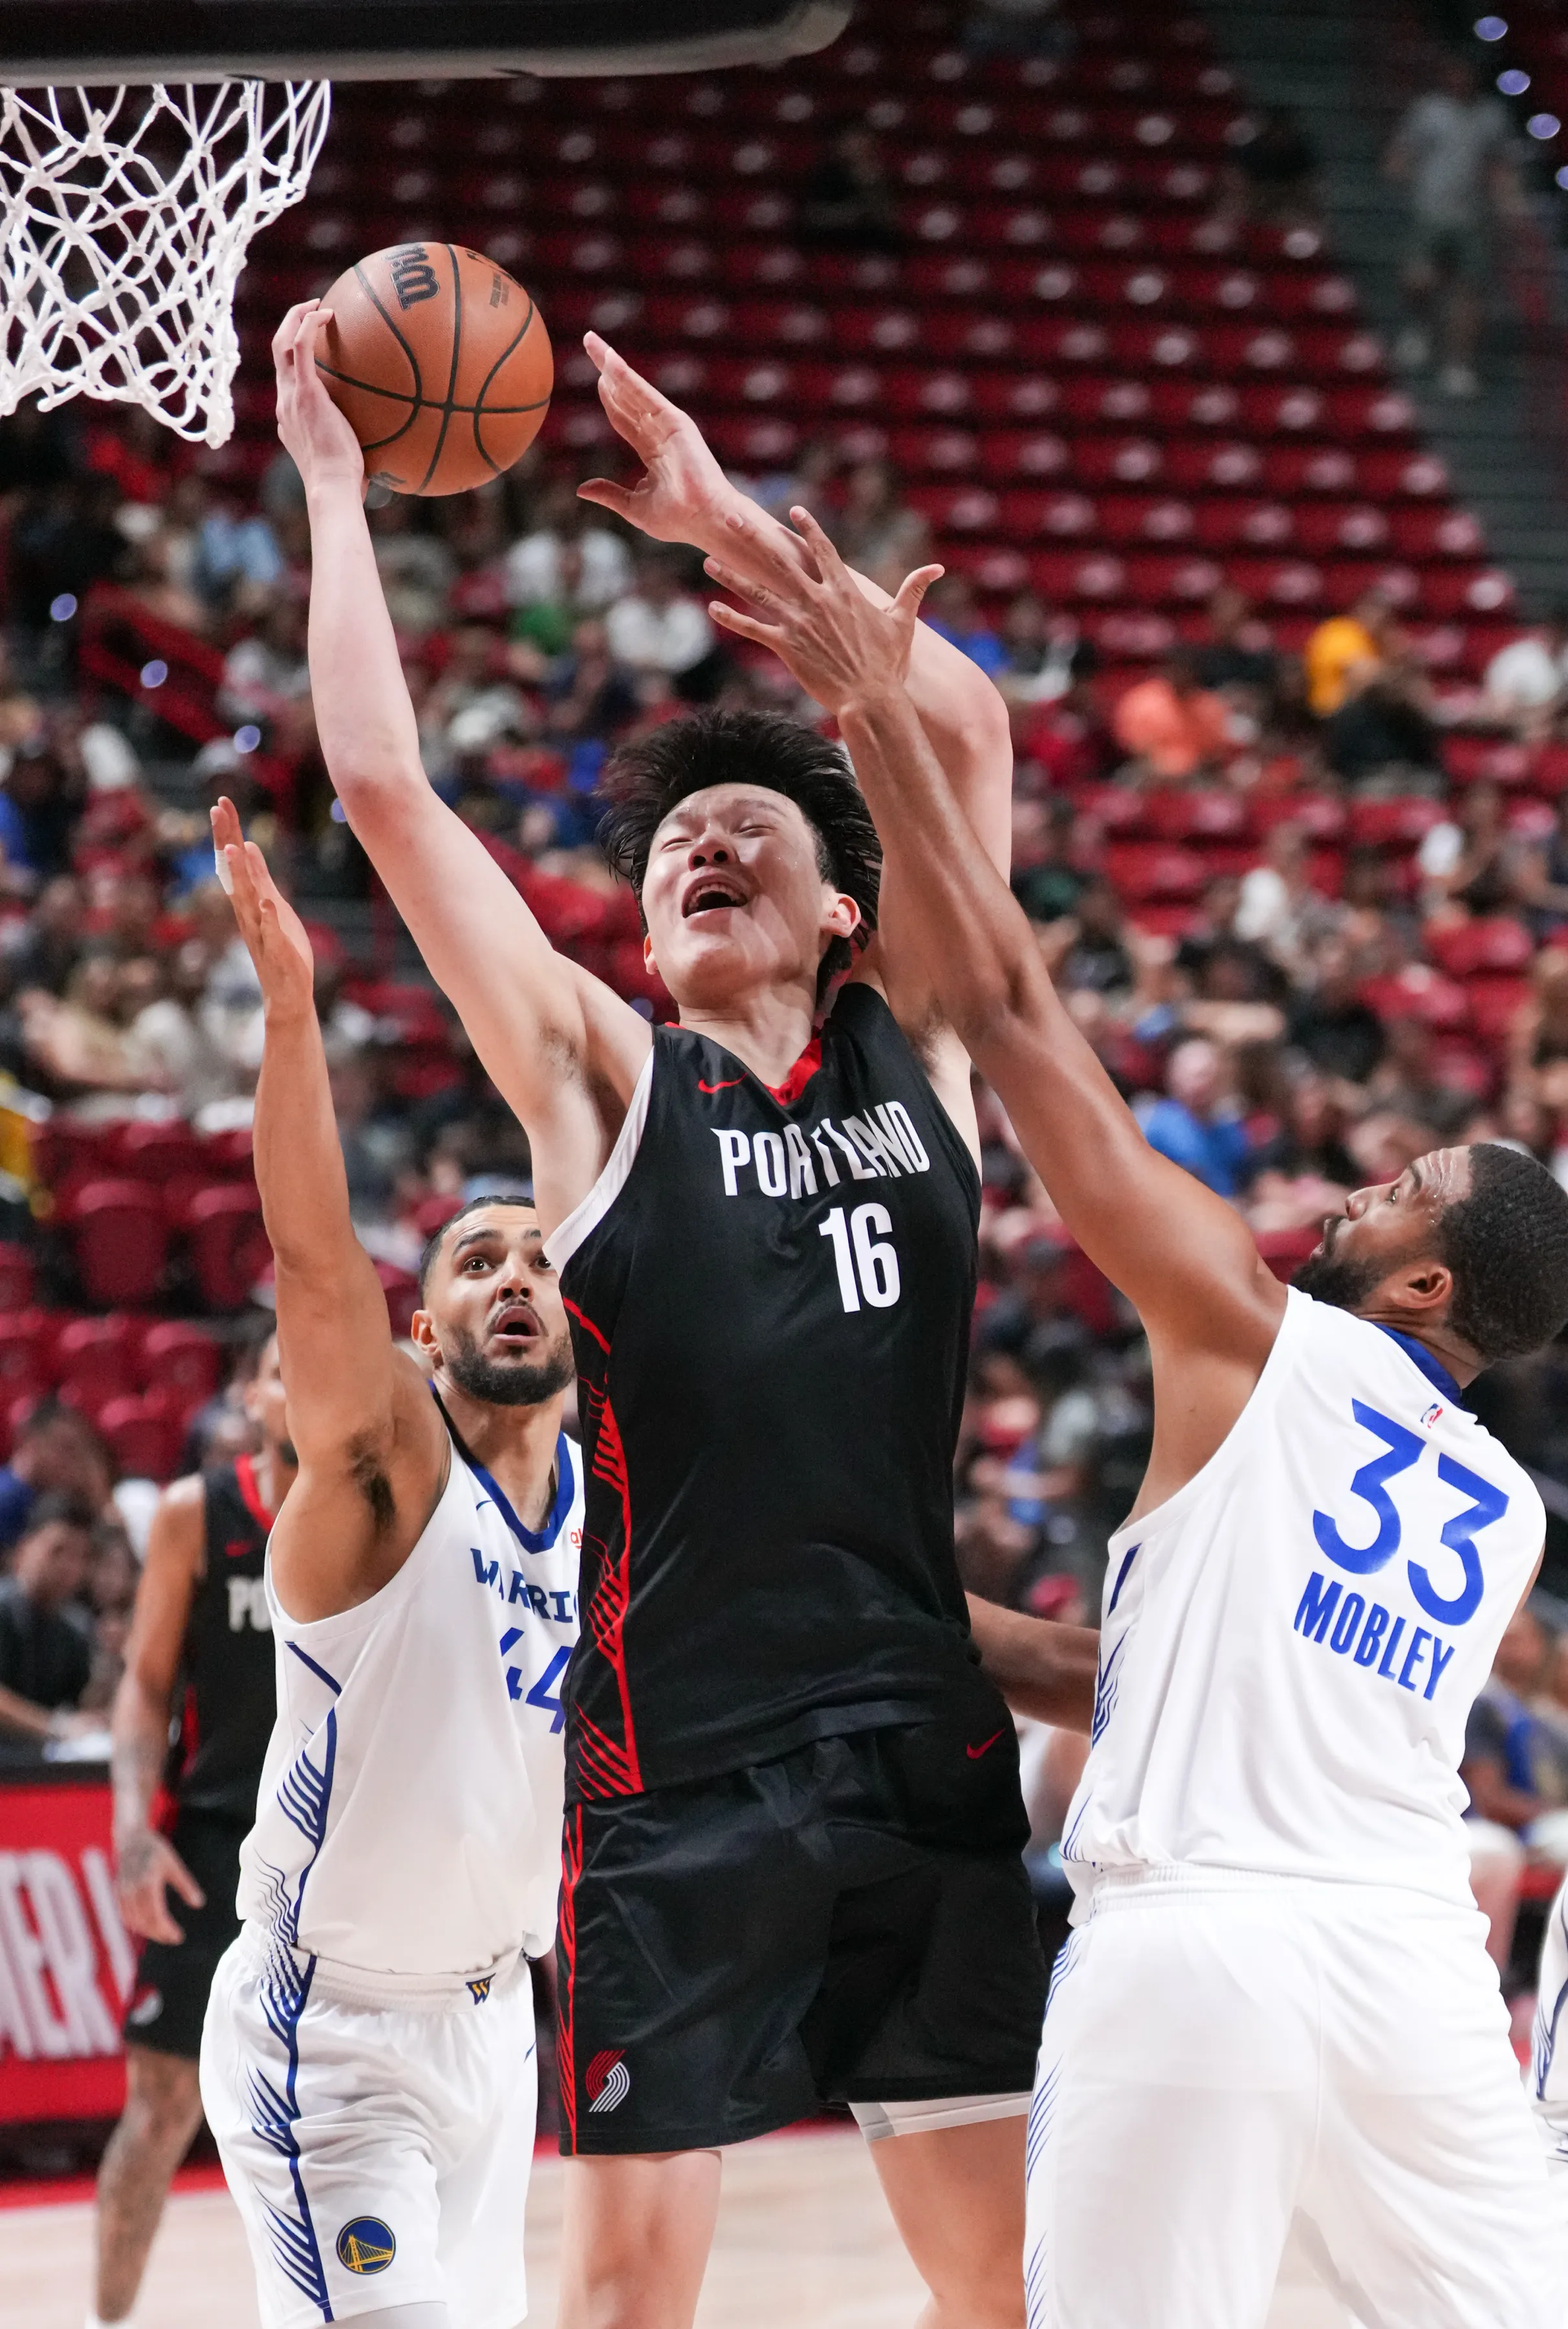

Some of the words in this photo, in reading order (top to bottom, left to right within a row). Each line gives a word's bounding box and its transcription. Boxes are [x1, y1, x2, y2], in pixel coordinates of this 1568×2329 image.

[710, 1100, 930, 1200] PORTLAND
[818, 1202, 901, 1313] 16
[1312, 1397, 1510, 1626] 33
[1293, 1571, 1456, 1701] MOBLEY
